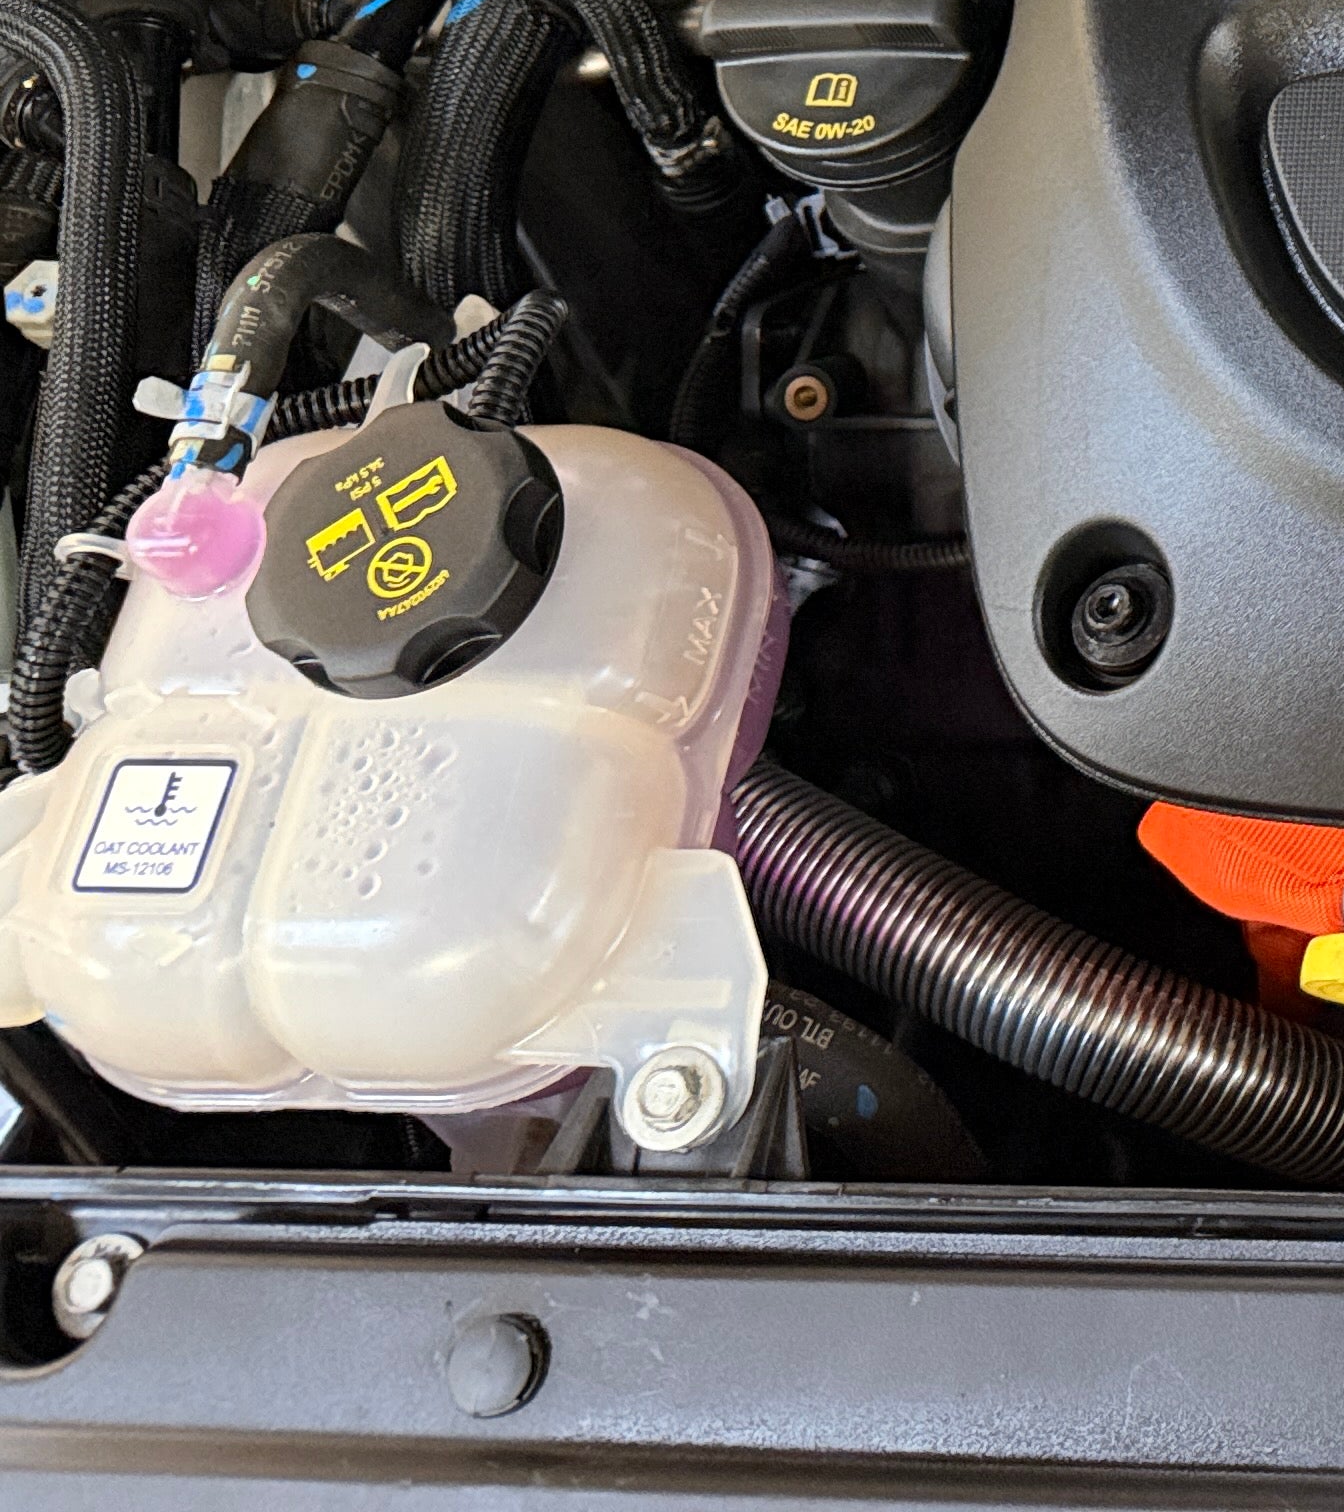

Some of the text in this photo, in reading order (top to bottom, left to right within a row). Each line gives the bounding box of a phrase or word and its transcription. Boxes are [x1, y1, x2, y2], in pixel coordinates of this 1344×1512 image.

[772, 112, 876, 141] SAE 0W-20
[350, 475, 382, 501] 5 PSI
[684, 587, 723, 667] MAX
[94, 840, 200, 856] OAT COOLANT
[103, 861, 175, 877] MS-12106
[763, 999, 798, 1030] OU
[801, 1015, 835, 1049] BTL
